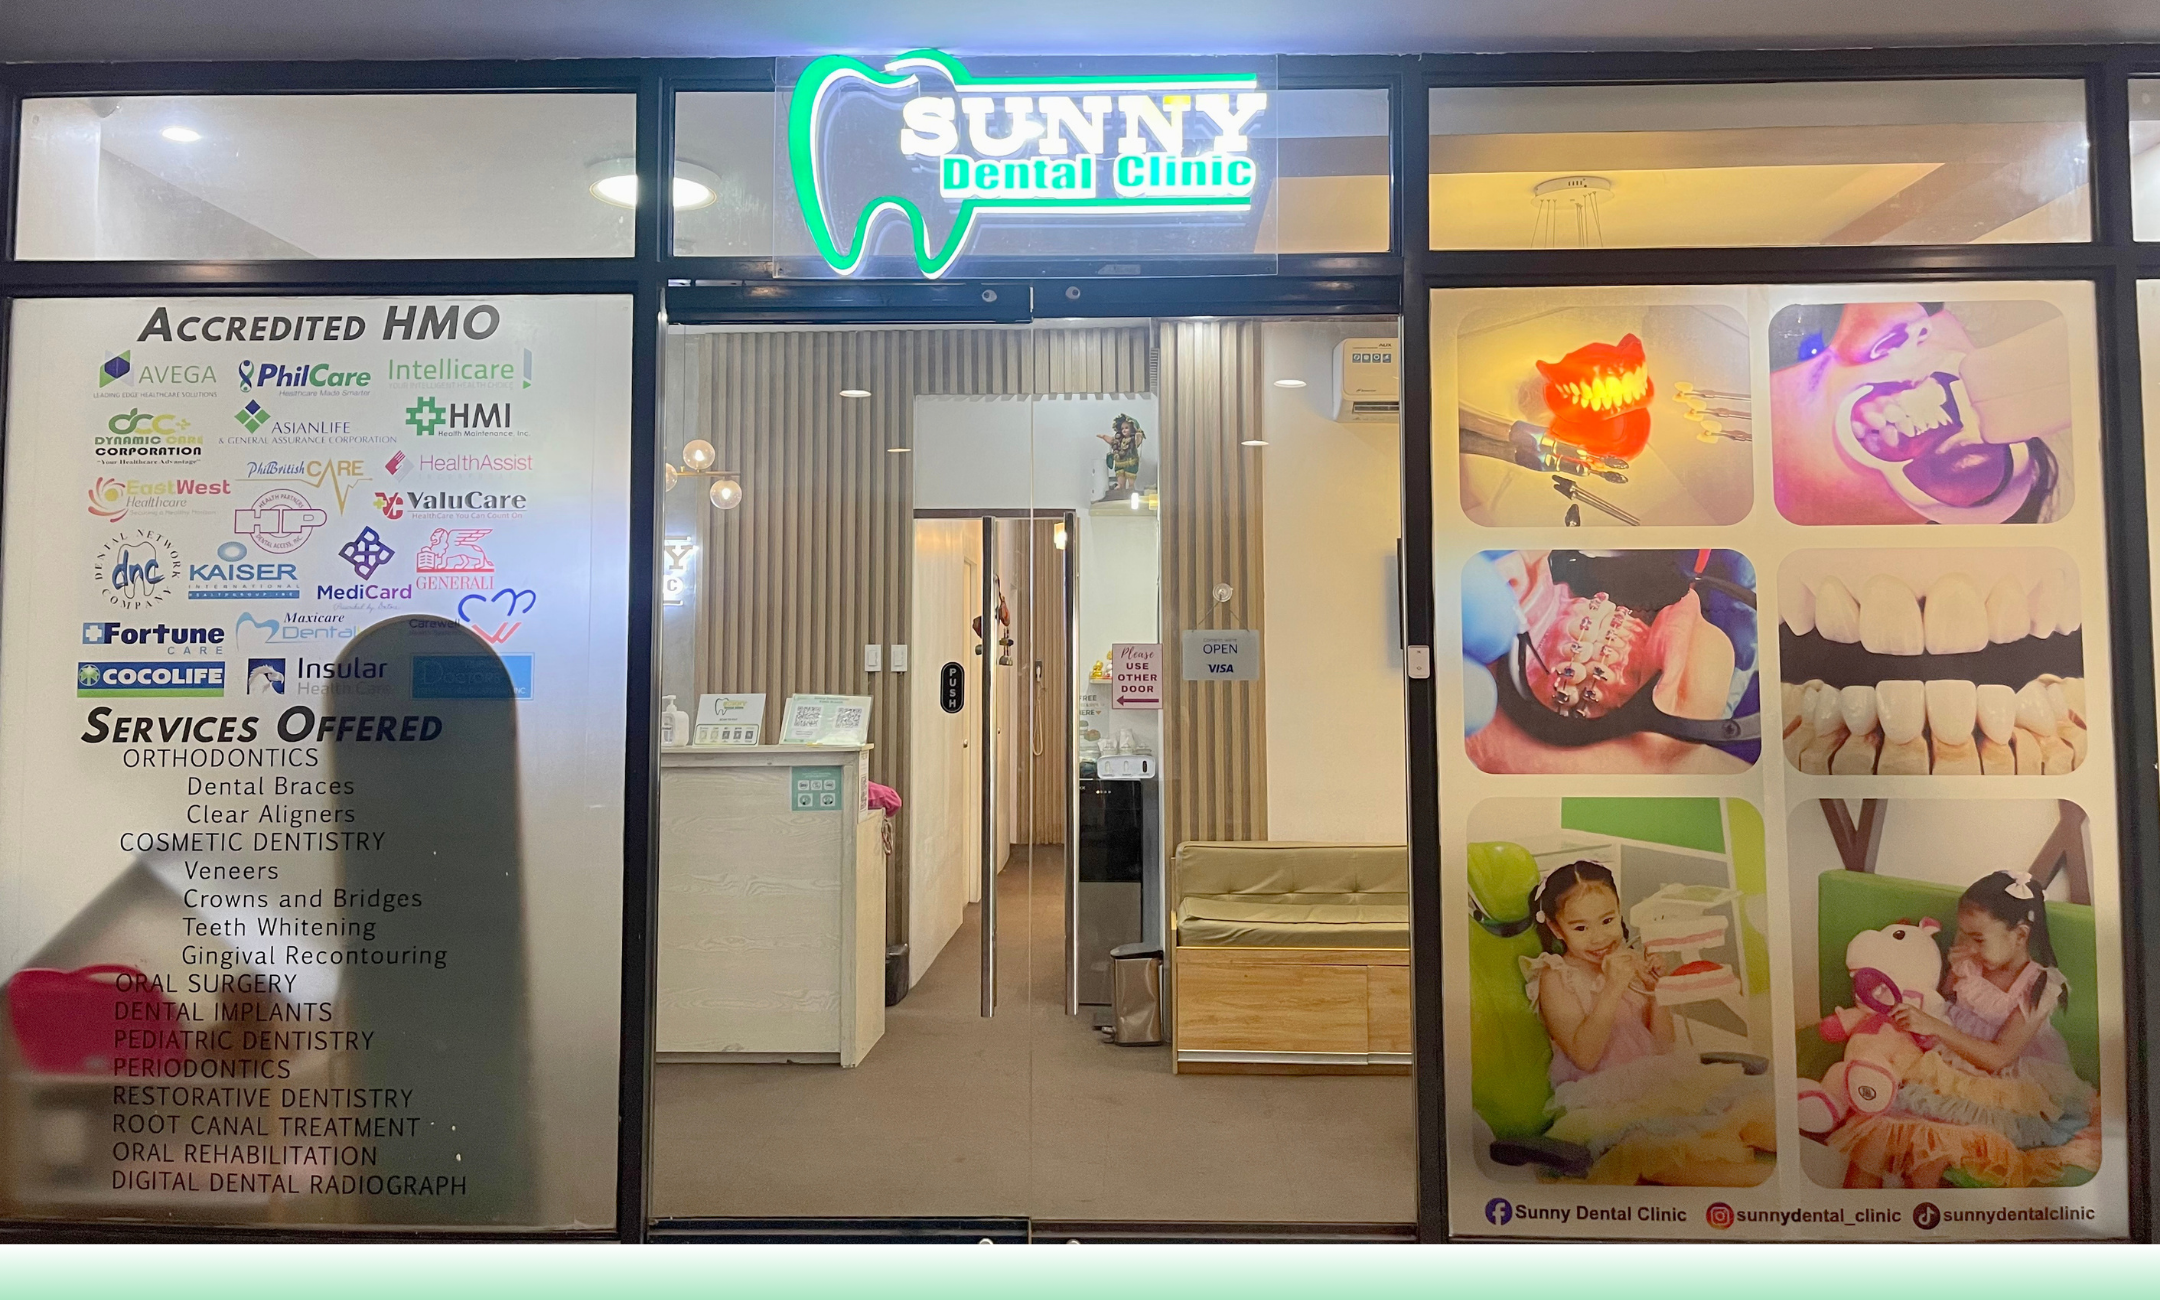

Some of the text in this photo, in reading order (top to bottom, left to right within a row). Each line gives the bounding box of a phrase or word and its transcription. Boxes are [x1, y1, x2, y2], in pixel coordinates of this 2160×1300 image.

[900, 92, 1267, 156] SUNNY
[942, 155, 1253, 191] Dental Clinic
[137, 304, 500, 342] ACCREDITED HMO
[139, 365, 217, 384] AVEGA
[257, 363, 371, 387] PhilCare
[389, 358, 515, 380] Intellicare
[450, 403, 511, 428] HMI
[271, 421, 351, 434] ASIANLIFE
[94, 436, 162, 445] DYNAMIC
[227, 436, 269, 444] GENERAL
[271, 436, 326, 444] ASSURANCE
[328, 435, 397, 444] CORPORATION
[95, 447, 202, 456] CORPORATION
[247, 460, 305, 478] PhilBritish
[420, 454, 533, 471] HealthAssist
[126, 479, 231, 495] EastWest
[126, 496, 188, 508] Healthcare
[258, 494, 305, 509] HEALTH PARTNERS
[407, 491, 527, 509] ValuCare
[255, 533, 272, 548] DENTAL
[136, 528, 181, 579] NETWORK
[112, 549, 166, 590] dnc
[189, 563, 298, 581] KAISER
[317, 584, 412, 600] MediCard
[416, 575, 495, 590] GENERALI
[283, 612, 345, 624] Maxicare
[409, 618, 460, 629] Carewell
[105, 622, 225, 645] Fortune
[282, 625, 357, 639] Dental
[167, 646, 224, 655] CARE
[1120, 645, 1155, 660] Please
[1203, 643, 1238, 655] OPEN
[298, 657, 388, 679] Insular
[1126, 662, 1149, 670] USE
[1208, 663, 1234, 673] VISA
[102, 668, 223, 685] COCOLIFE
[1117, 673, 1158, 682] OTHER
[948, 668, 957, 708] PUSH
[1121, 685, 1154, 693] DOOR
[81, 705, 444, 744] SERVICES OFFERED
[123, 747, 319, 768] ORTHODONTICS
[187, 776, 355, 796] Dental Braces
[187, 804, 356, 827] Clear Aligners
[120, 831, 386, 852] COSMETIC DENTISTRY
[184, 860, 279, 880] Veneers
[183, 888, 423, 913] Crowns and Bridges
[182, 917, 377, 941] Teeth Whitening
[182, 945, 448, 970] Gingival Recontouring
[115, 972, 298, 994] ORAL SURGERY
[114, 1001, 333, 1023] DENTAL IMPLANTS
[114, 1029, 375, 1052] PEDIATRIC DENTISTRY
[114, 1057, 291, 1079] PERIODONTICS
[113, 1085, 414, 1109] RESTORATIVE DENTISTRY
[113, 1113, 421, 1138] ROOT CANAL TREATMENT
[112, 1141, 378, 1167] ORAL REHABILITATION
[111, 1169, 468, 1197] DIGITAL DENTAL RADIOGRAPH
[1515, 1204, 1687, 1223] Sunny Dental Clinic
[1736, 1207, 1902, 1227] sunnydental_clinic
[1943, 1206, 2096, 1224] sunnydentalclinic
